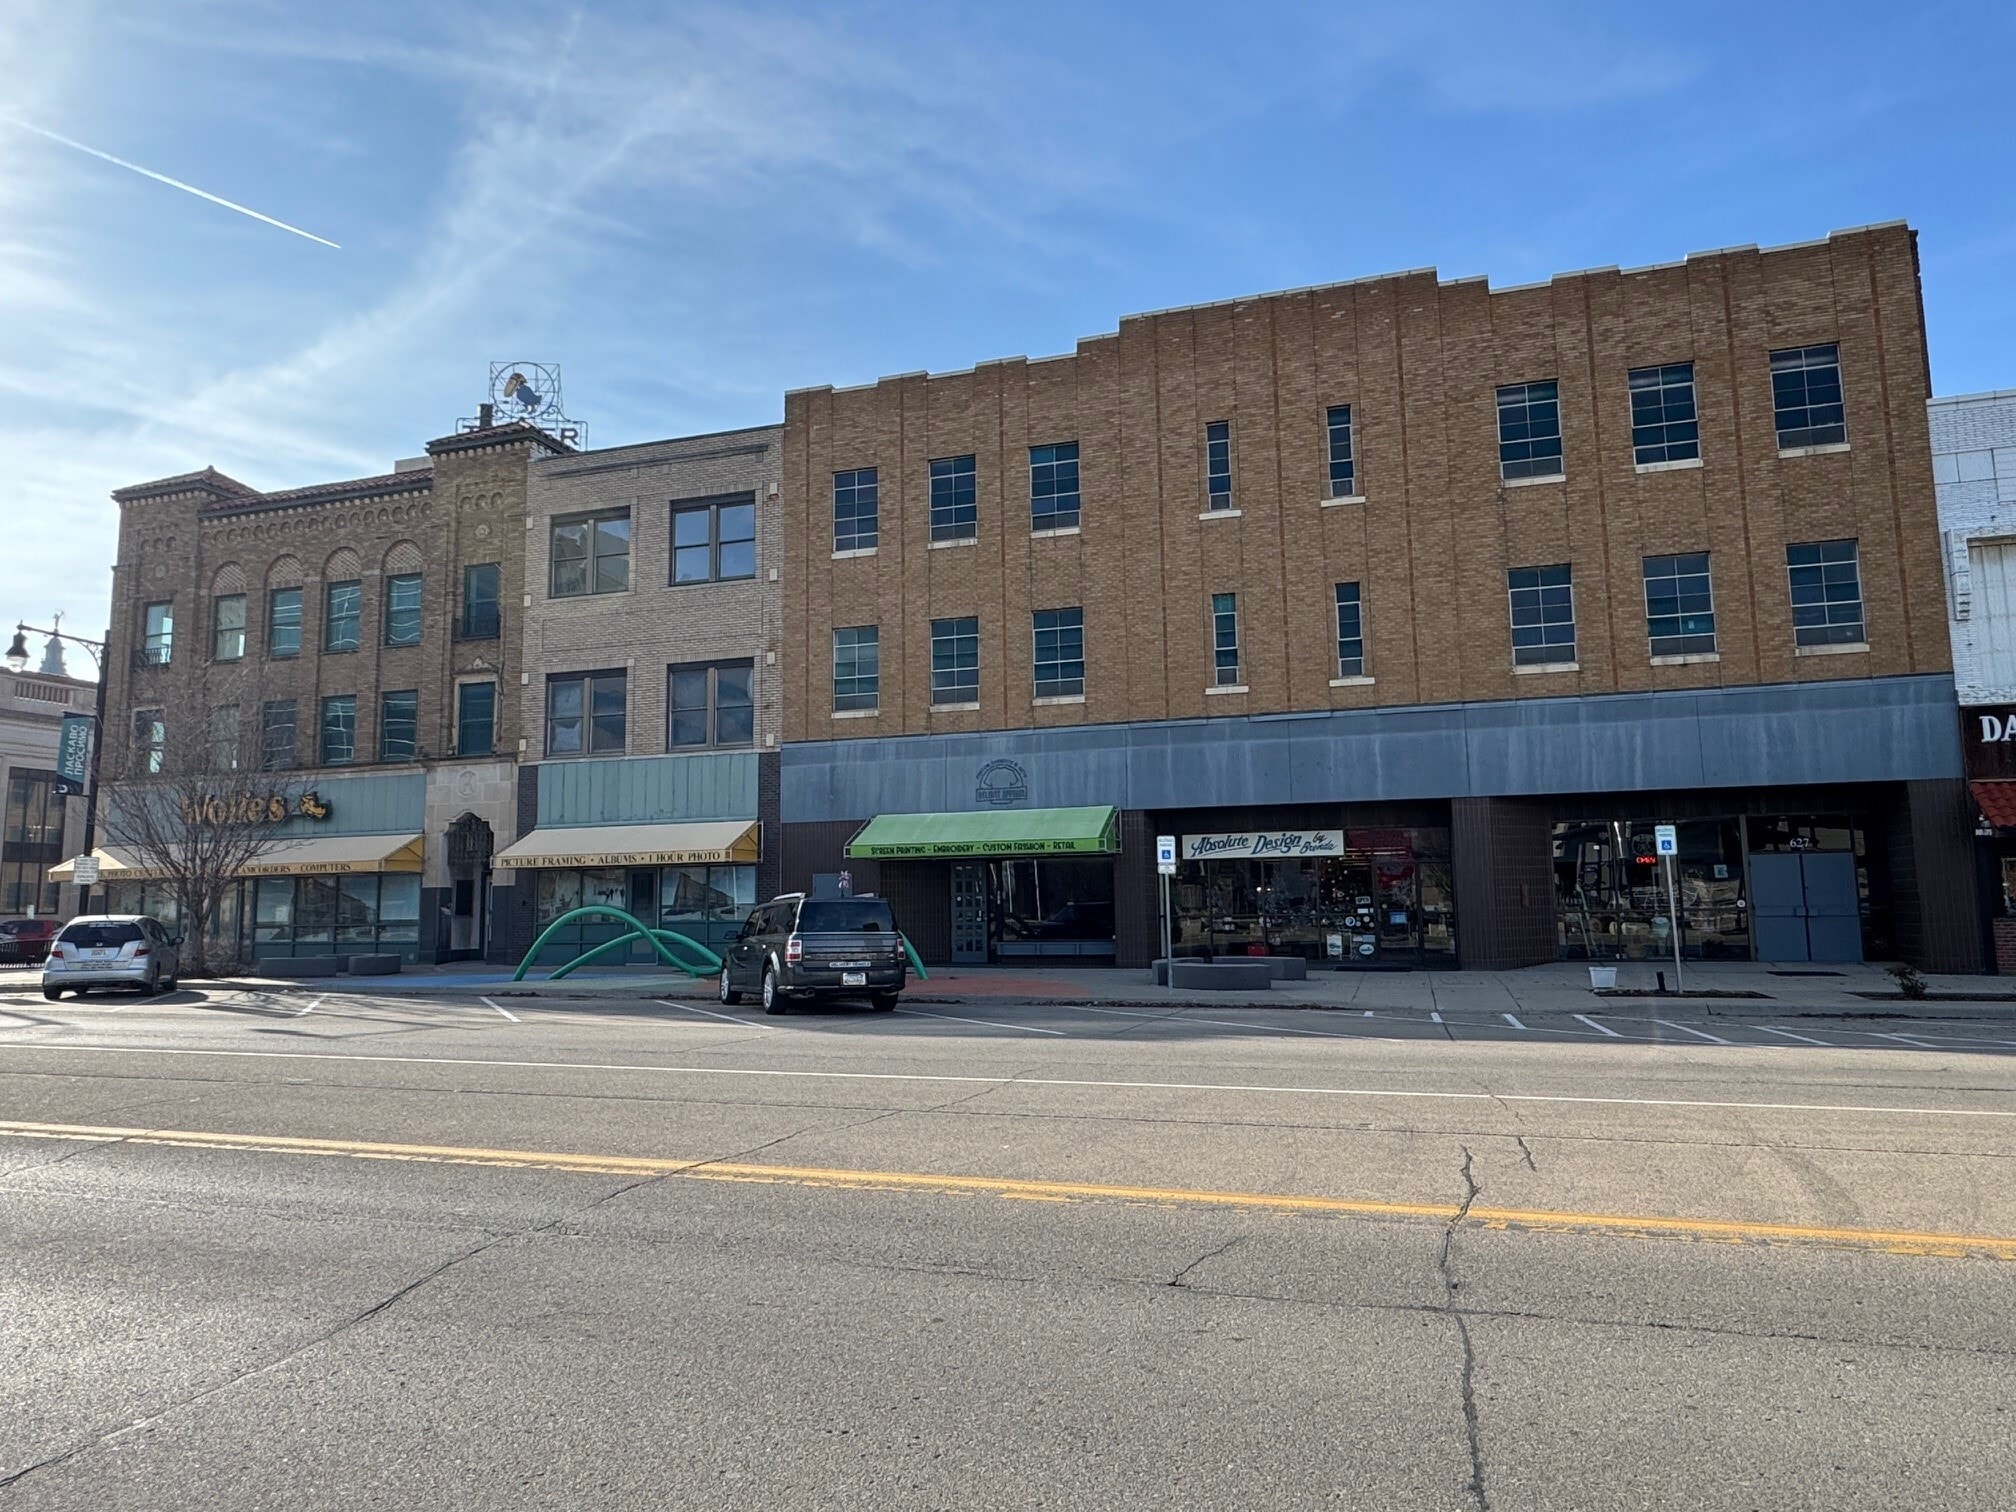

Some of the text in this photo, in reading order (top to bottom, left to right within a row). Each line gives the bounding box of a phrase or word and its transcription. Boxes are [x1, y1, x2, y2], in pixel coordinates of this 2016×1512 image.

[64, 724, 79, 775] ЛАСКАВО
[74, 725, 87, 775] ПРОСИМО
[870, 846, 895, 855] SCREEN
[896, 845, 926, 854] PRINTING
[933, 844, 974, 854] EMBROIDERY
[982, 842, 1012, 852] CUSTOM
[1013, 841, 1046, 851] FASHION
[1053, 841, 1076, 850] RETAIL
[1190, 834, 1250, 857] Absolute
[1250, 833, 1301, 855] Design
[1312, 832, 1327, 843] by
[1789, 837, 1809, 848] 627
[501, 856, 539, 867] PICTURE
[542, 855, 586, 865] FRAMING
[598, 854, 637, 864] ALBUMS
[656, 853, 684, 863] HOUR
[688, 851, 721, 862] PHOTO
[300, 863, 351, 873] COMPUTERS
